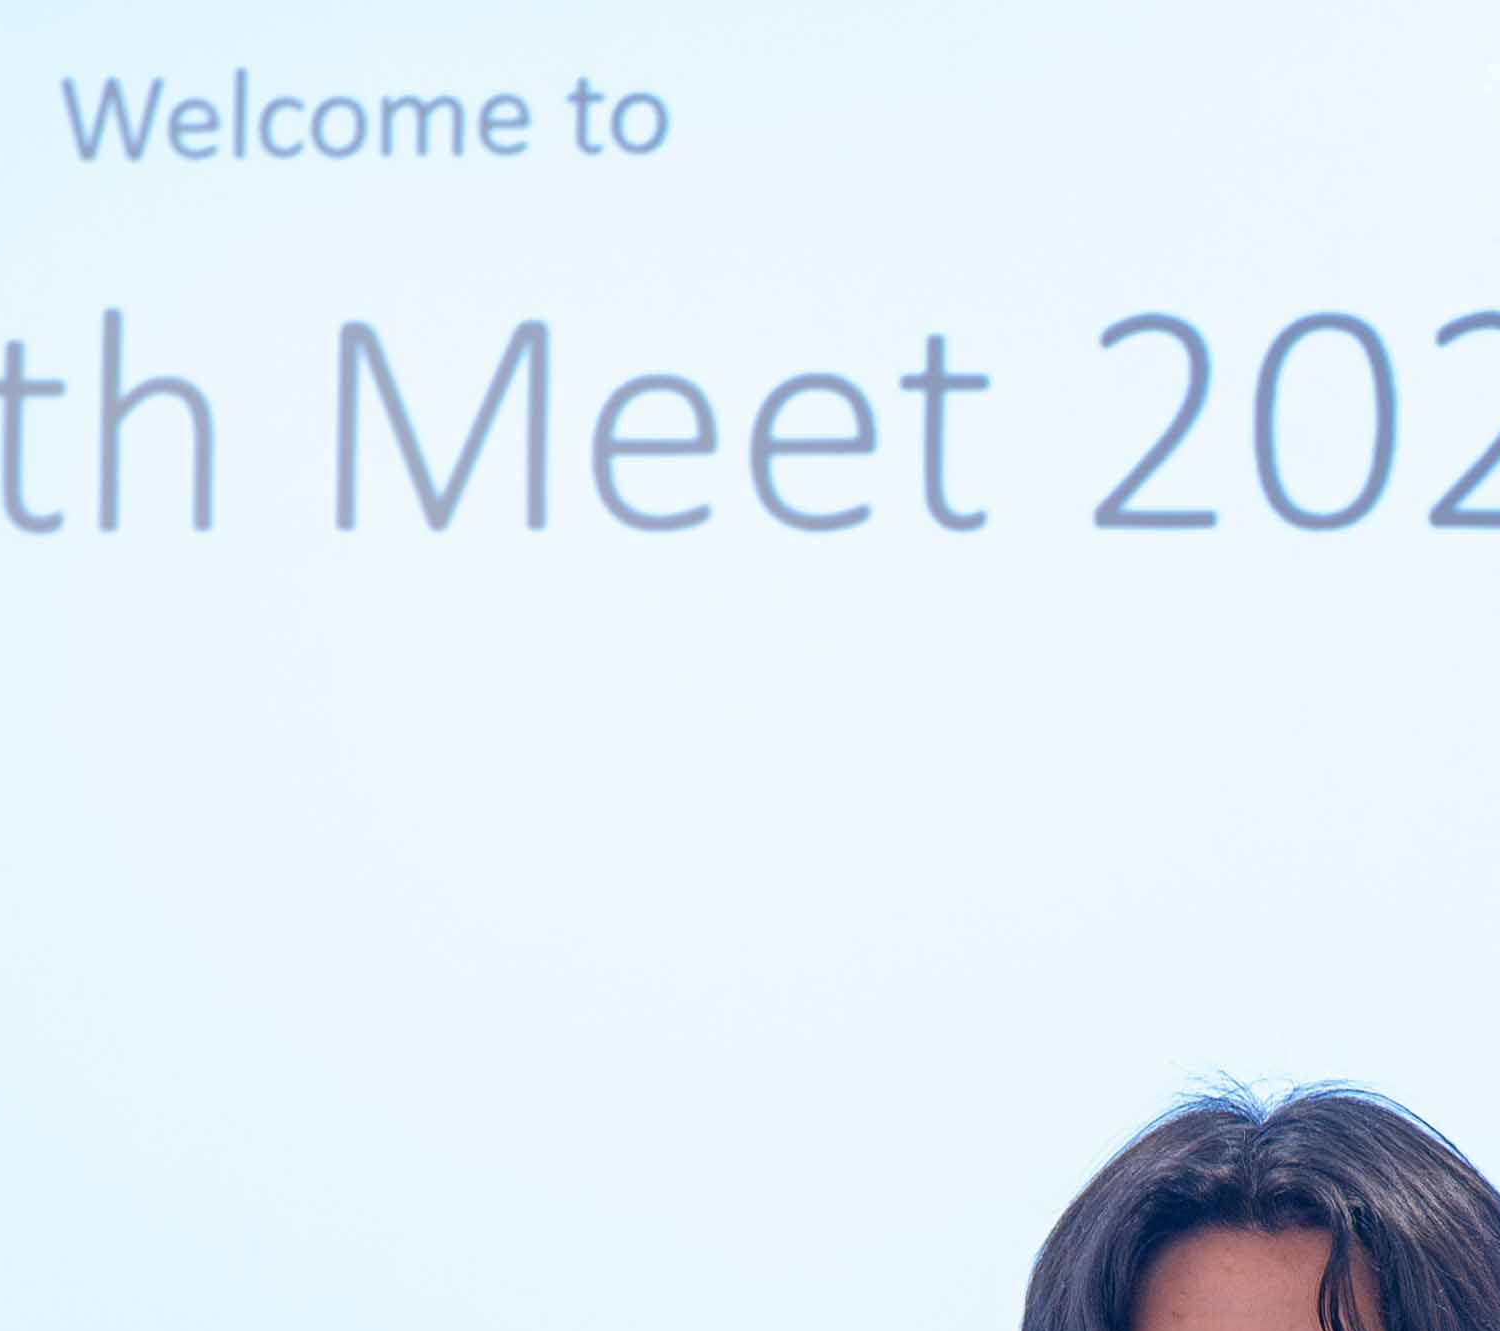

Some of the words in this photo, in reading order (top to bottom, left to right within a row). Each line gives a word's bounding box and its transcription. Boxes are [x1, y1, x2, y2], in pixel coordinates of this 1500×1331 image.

[60, 64, 533, 163] Welcome
[566, 74, 671, 157] to
[334, 318, 990, 534] Meet
